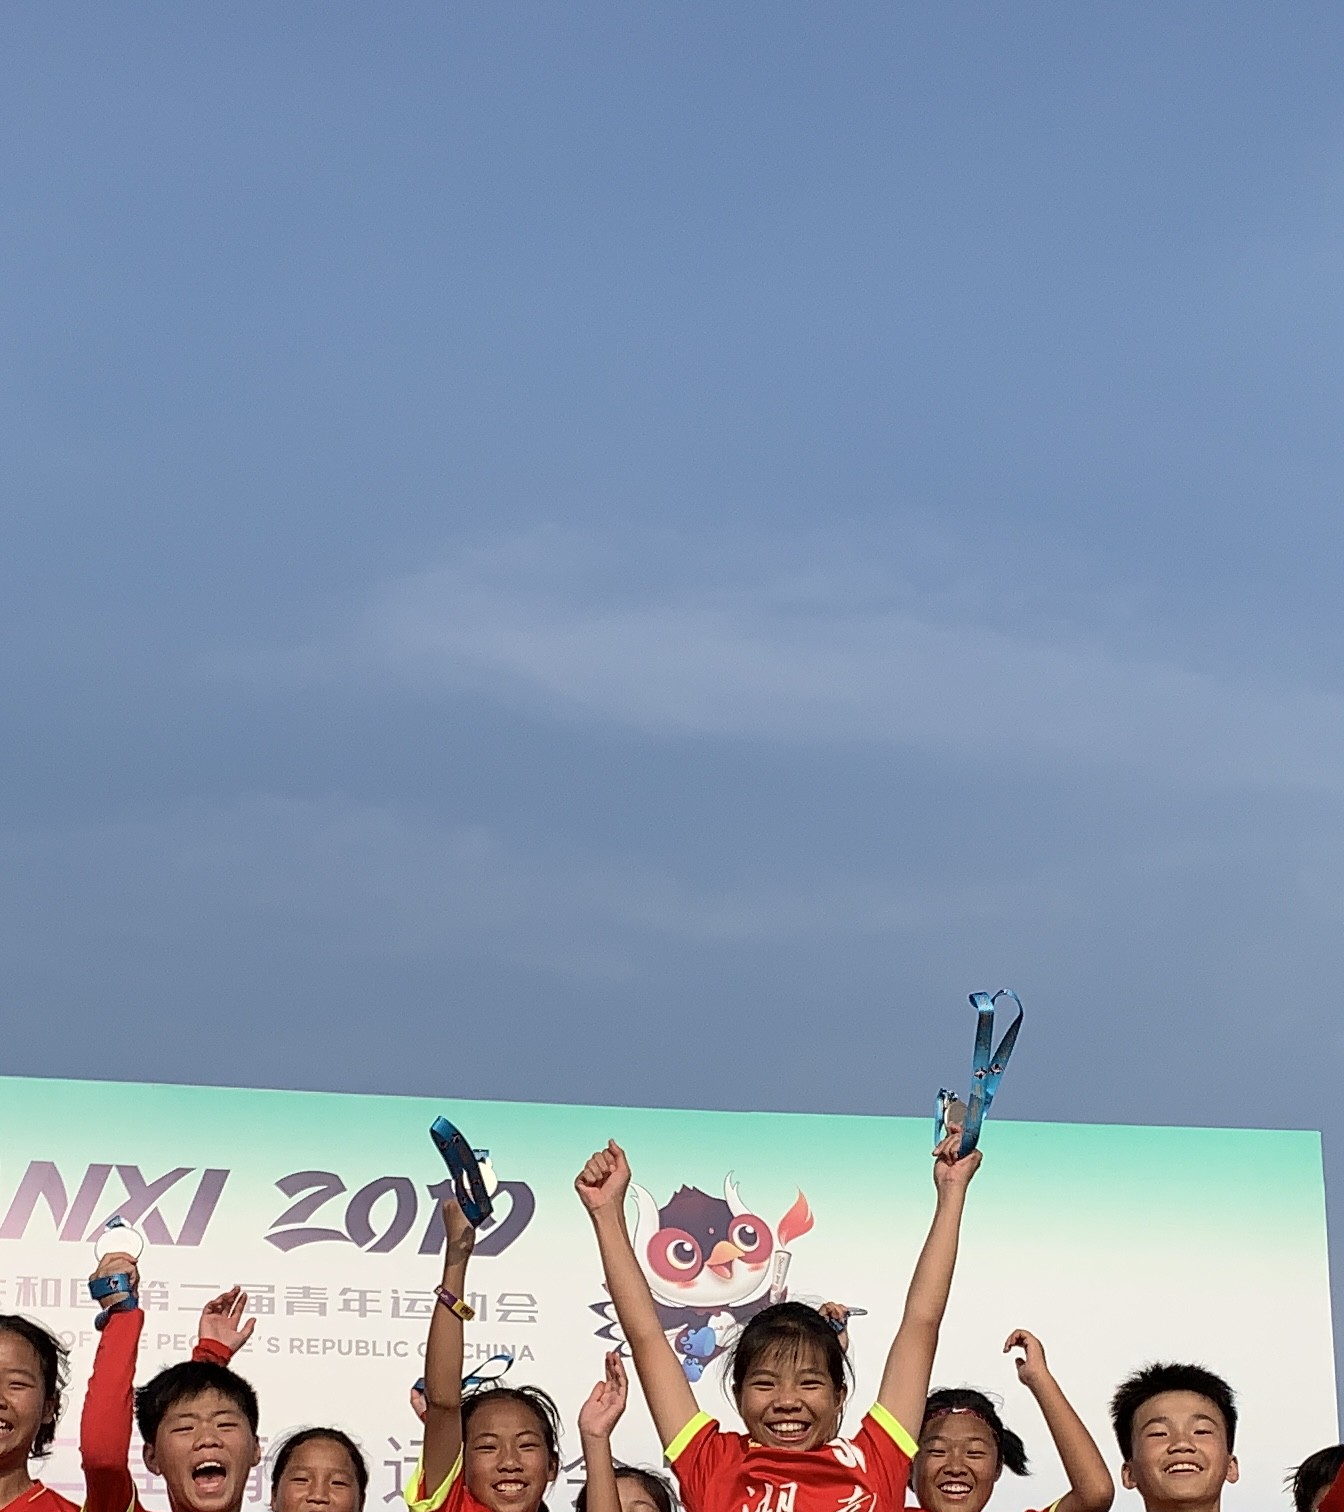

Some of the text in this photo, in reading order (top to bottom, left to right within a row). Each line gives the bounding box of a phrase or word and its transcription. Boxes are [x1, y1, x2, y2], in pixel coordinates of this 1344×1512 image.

[263, 1170, 536, 1257] 2019
[156, 1332, 281, 1354] PEOE'S
[289, 1336, 409, 1358] REPUBLIC
